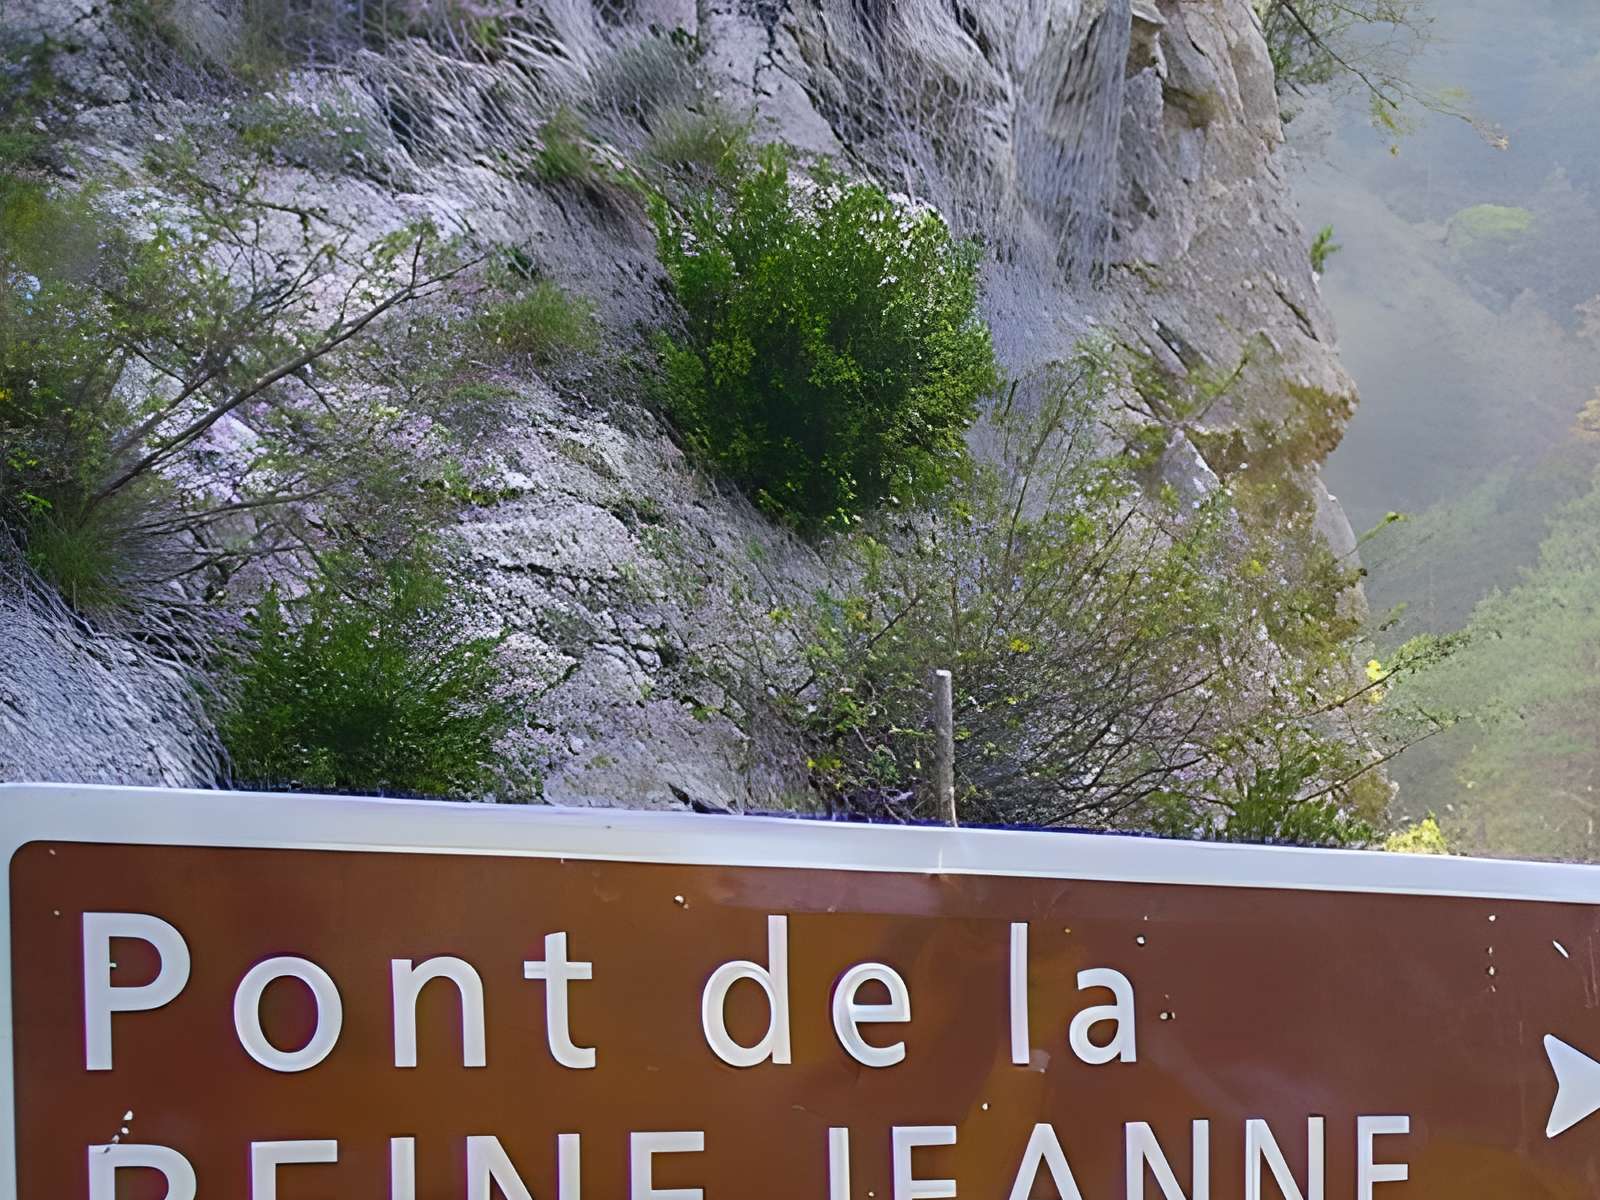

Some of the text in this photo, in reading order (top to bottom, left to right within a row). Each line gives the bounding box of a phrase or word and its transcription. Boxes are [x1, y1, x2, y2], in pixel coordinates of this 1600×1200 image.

[82, 911, 1138, 1072] Pont de la
